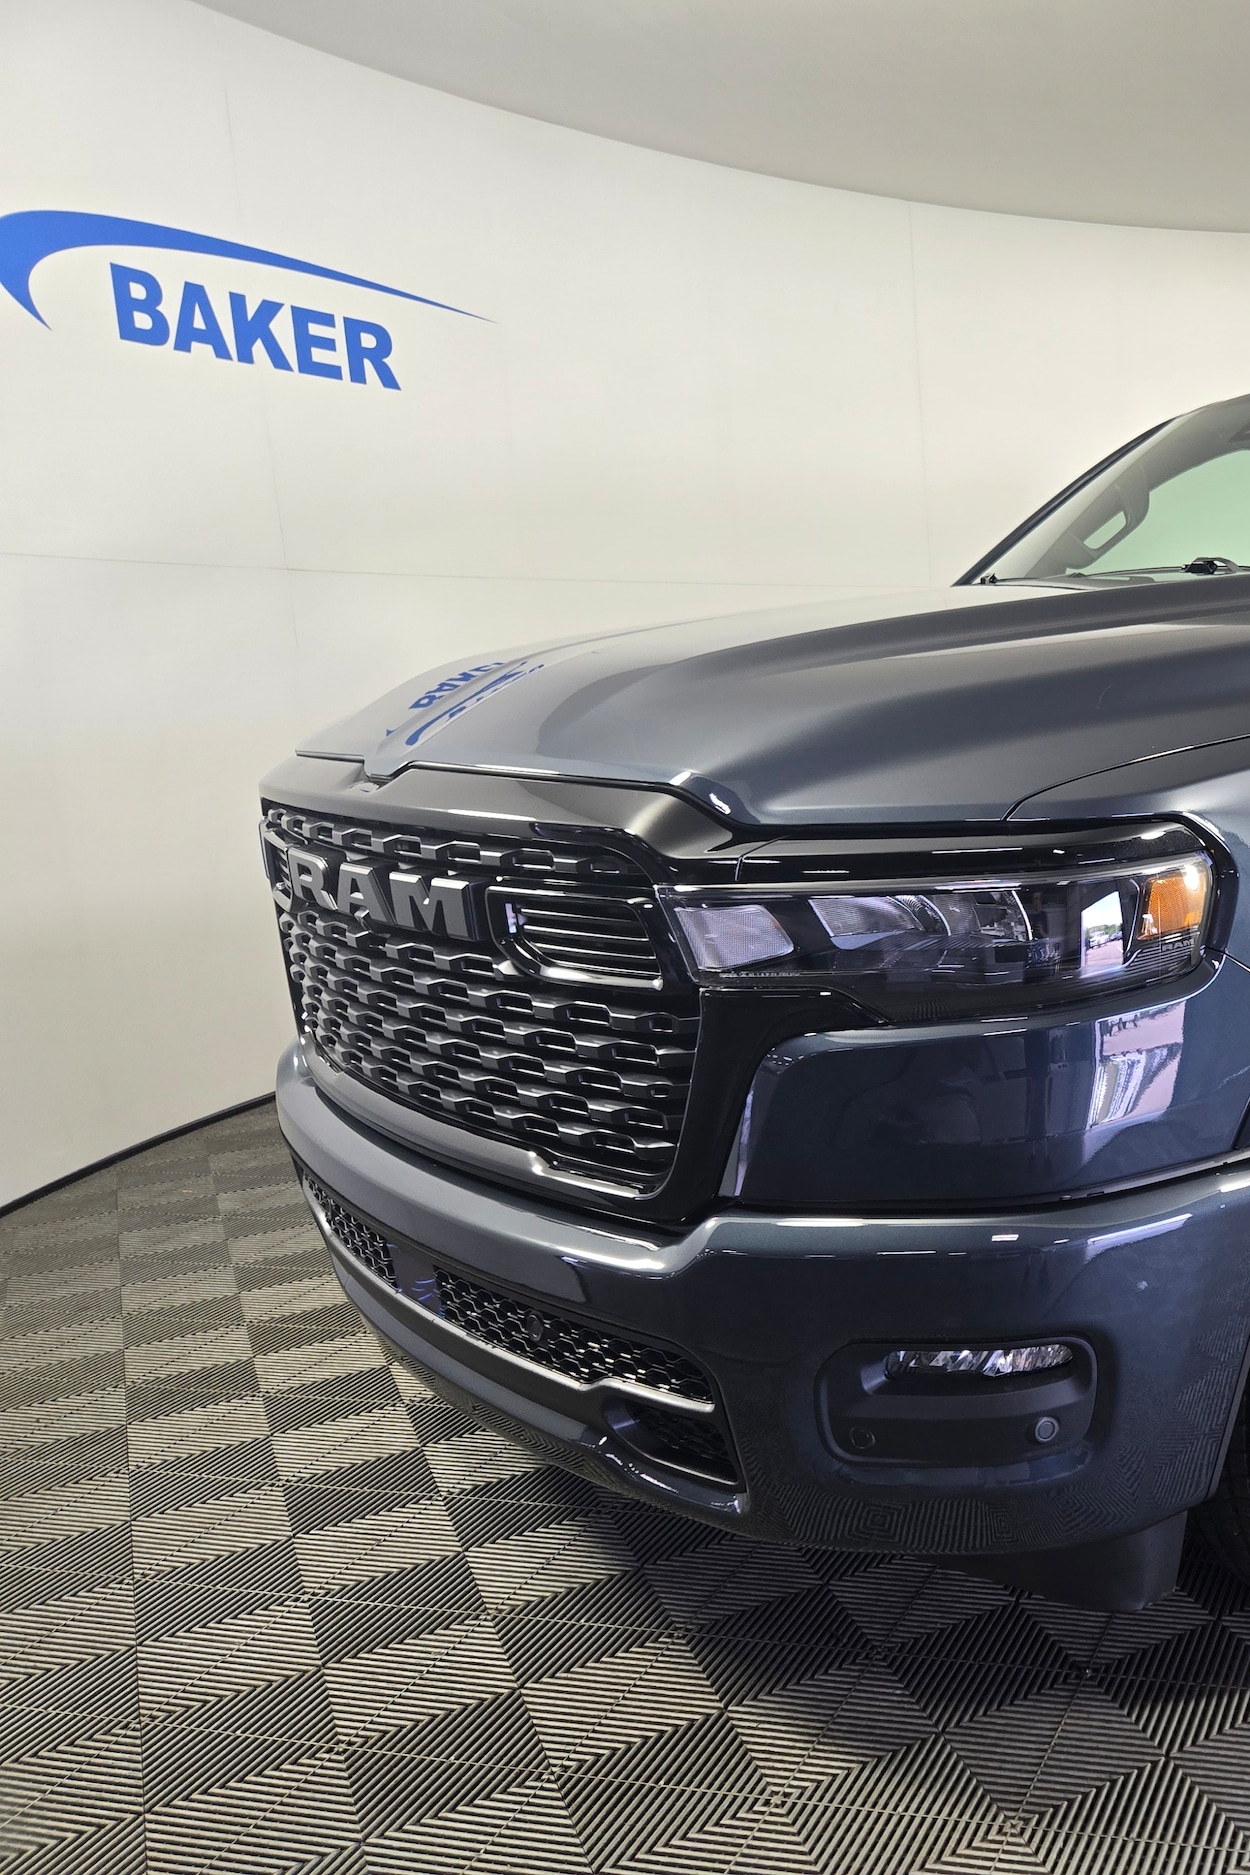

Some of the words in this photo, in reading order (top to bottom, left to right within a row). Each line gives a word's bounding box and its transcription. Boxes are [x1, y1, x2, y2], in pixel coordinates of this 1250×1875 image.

[110, 262, 401, 391] BAKER
[287, 846, 475, 941] RAM
[1162, 939, 1194, 951] RAM
